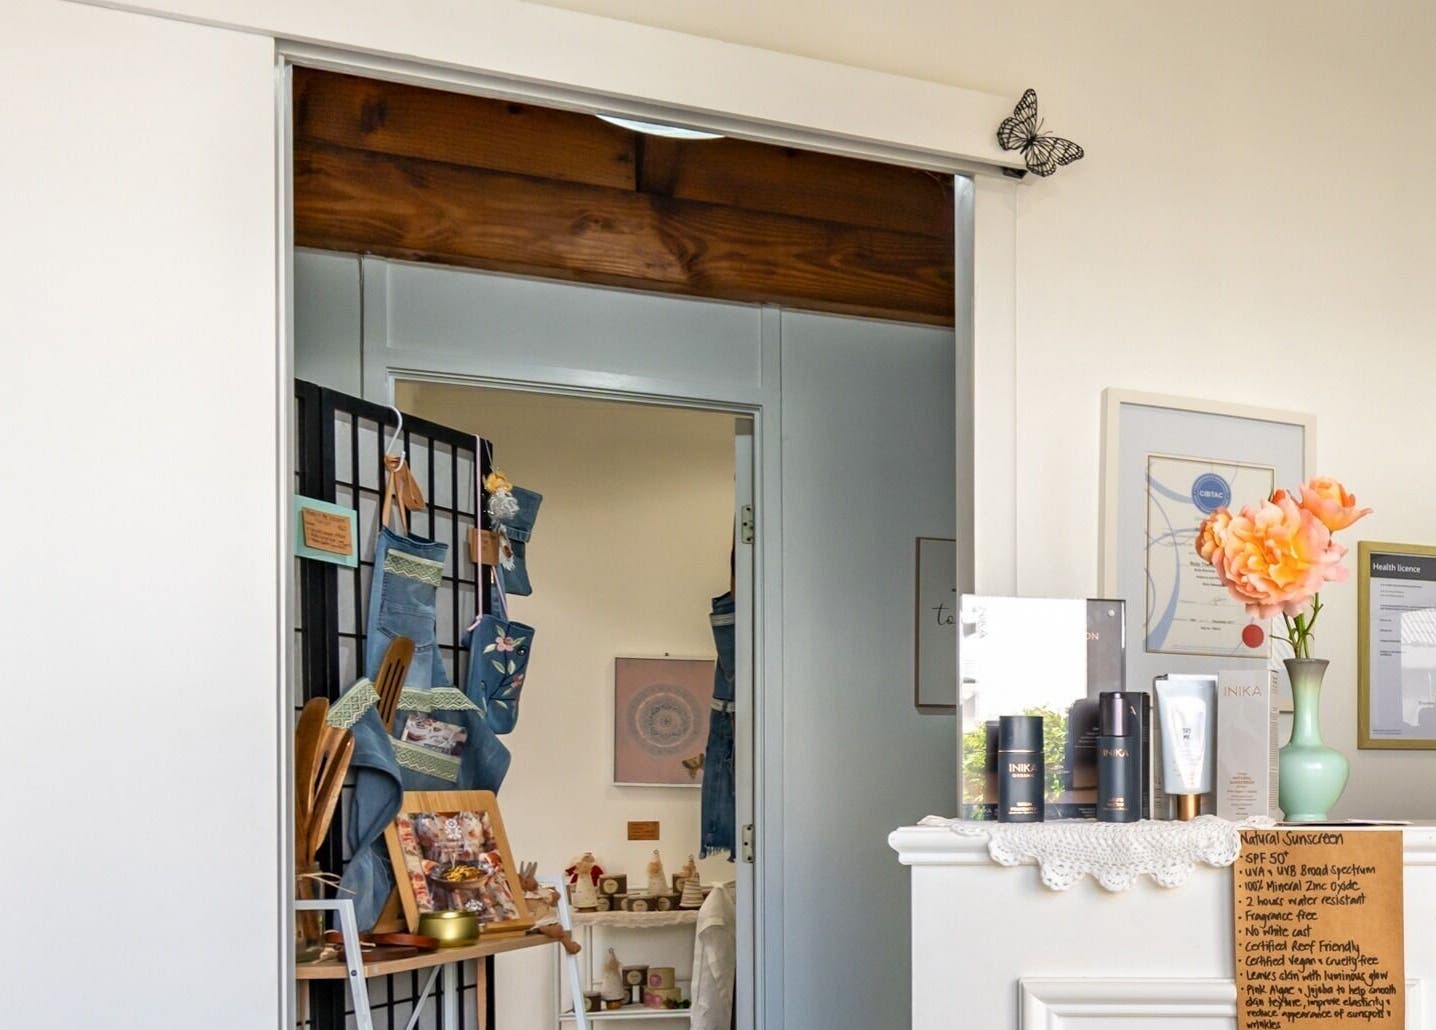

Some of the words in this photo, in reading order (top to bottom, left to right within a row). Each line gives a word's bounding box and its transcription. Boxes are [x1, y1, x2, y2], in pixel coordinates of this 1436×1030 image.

[1373, 563, 1396, 572] Health
[1397, 565, 1421, 574] licence
[1223, 686, 1262, 697] INIKA
[1240, 831, 1280, 846] Natural
[1283, 830, 1344, 846] Sunscreen
[1245, 852, 1267, 864] SPF
[1245, 866, 1265, 877] UVA
[1277, 866, 1296, 877] UVB
[1300, 865, 1328, 876] Broad
[1244, 880, 1264, 891] 100%
[1266, 880, 1302, 892] Mineral
[1306, 881, 1327, 891] Zinc
[1246, 897, 1254, 907] 2
[1257, 895, 1284, 906] hours
[1288, 895, 1318, 906] water
[1321, 893, 1366, 905] resistant
[1245, 910, 1293, 928] Fragrance
[1296, 910, 1318, 921] free
[1245, 926, 1259, 936] No
[1263, 926, 1289, 937] white
[1292, 926, 1312, 937] cast
[1245, 941, 1287, 952] Certified
[1292, 941, 1315, 953] Reef
[1319, 940, 1360, 958] Friendly
[1245, 956, 1284, 966] Certified
[1357, 956, 1379, 966] free
[1246, 970, 1276, 981] Leaves
[1279, 970, 1299, 981] skin
[1302, 970, 1321, 981] with
[1324, 970, 1365, 981] luminous
[1364, 970, 1388, 986] glow
[1246, 985, 1267, 995] Pink
[1270, 985, 1295, 999] Algae
[1336, 984, 1346, 994] to
[1349, 985, 1366, 997] help
[1368, 983, 1396, 995] smooth
[1245, 997, 1264, 1007] skin
[1307, 998, 1340, 1010] improve
[1343, 997, 1385, 1011] elasticity
[1247, 1009, 1279, 1018] reduce
[1282, 1010, 1333, 1023] appearance
[1334, 1009, 1344, 1018] of
[1347, 1009, 1384, 1022] sunspots
[1246, 1020, 1281, 1030] wrinkles
